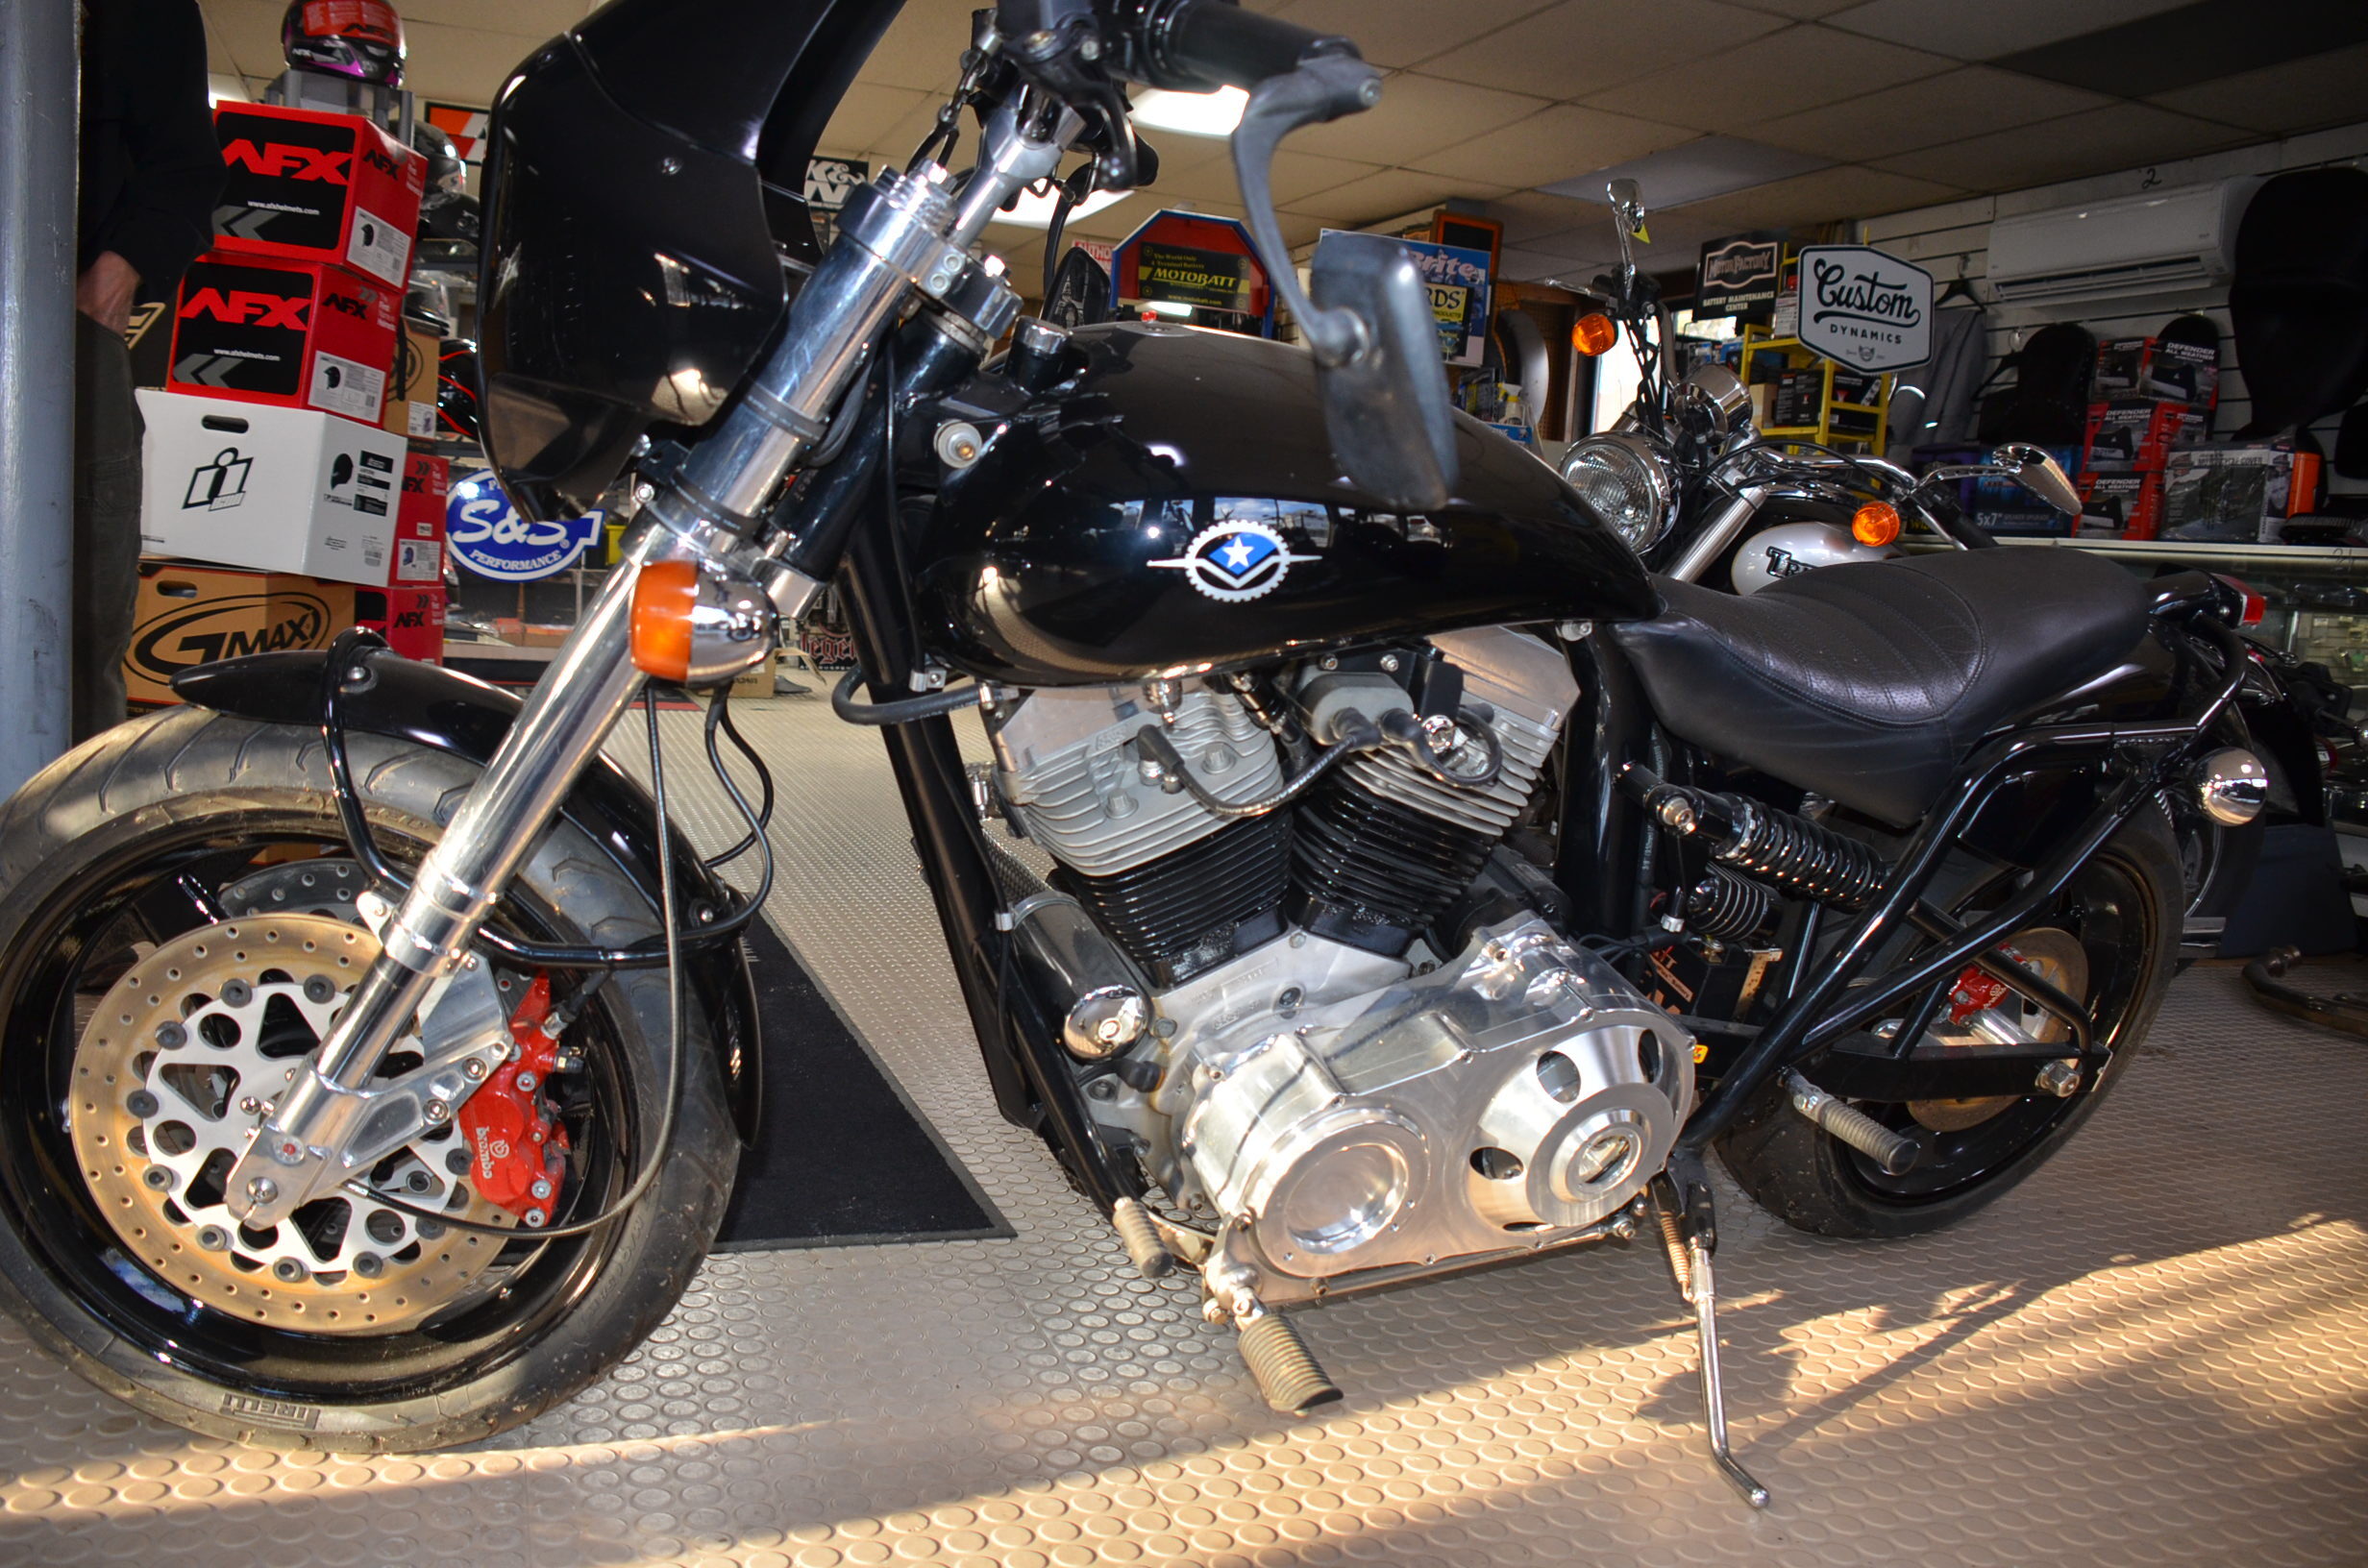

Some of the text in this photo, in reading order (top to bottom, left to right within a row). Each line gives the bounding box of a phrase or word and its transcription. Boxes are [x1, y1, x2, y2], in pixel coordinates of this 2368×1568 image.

[221, 138, 352, 186] AFX
[363, 149, 400, 181] AFX
[2142, 167, 2162, 190] 2
[247, 201, 320, 215] www.afxhelmets.com
[1153, 267, 1237, 288] MOTOBATT
[1703, 291, 1775, 306] BATTERY MAINTENANCE
[1813, 257, 1921, 328] Custom
[178, 286, 312, 331] AFX
[322, 292, 369, 320] AFX
[1725, 302, 1749, 312] CENTER
[1830, 323, 1903, 345] DYNAMICS
[2166, 342, 2216, 355] DEFENDER
[2180, 350, 2215, 361] WEATHER
[2106, 408, 2153, 417] DEFENDER
[2117, 413, 2152, 422] WEATHER
[402, 476, 426, 494] FX
[2095, 478, 2142, 487] DEFENDER
[453, 499, 568, 547] S&S
[469, 549, 563, 572] PERFORMANCE
[393, 611, 426, 628] AFX
[475, 1125, 496, 1180] brembo
[219, 1391, 322, 1432] PIRELLI
